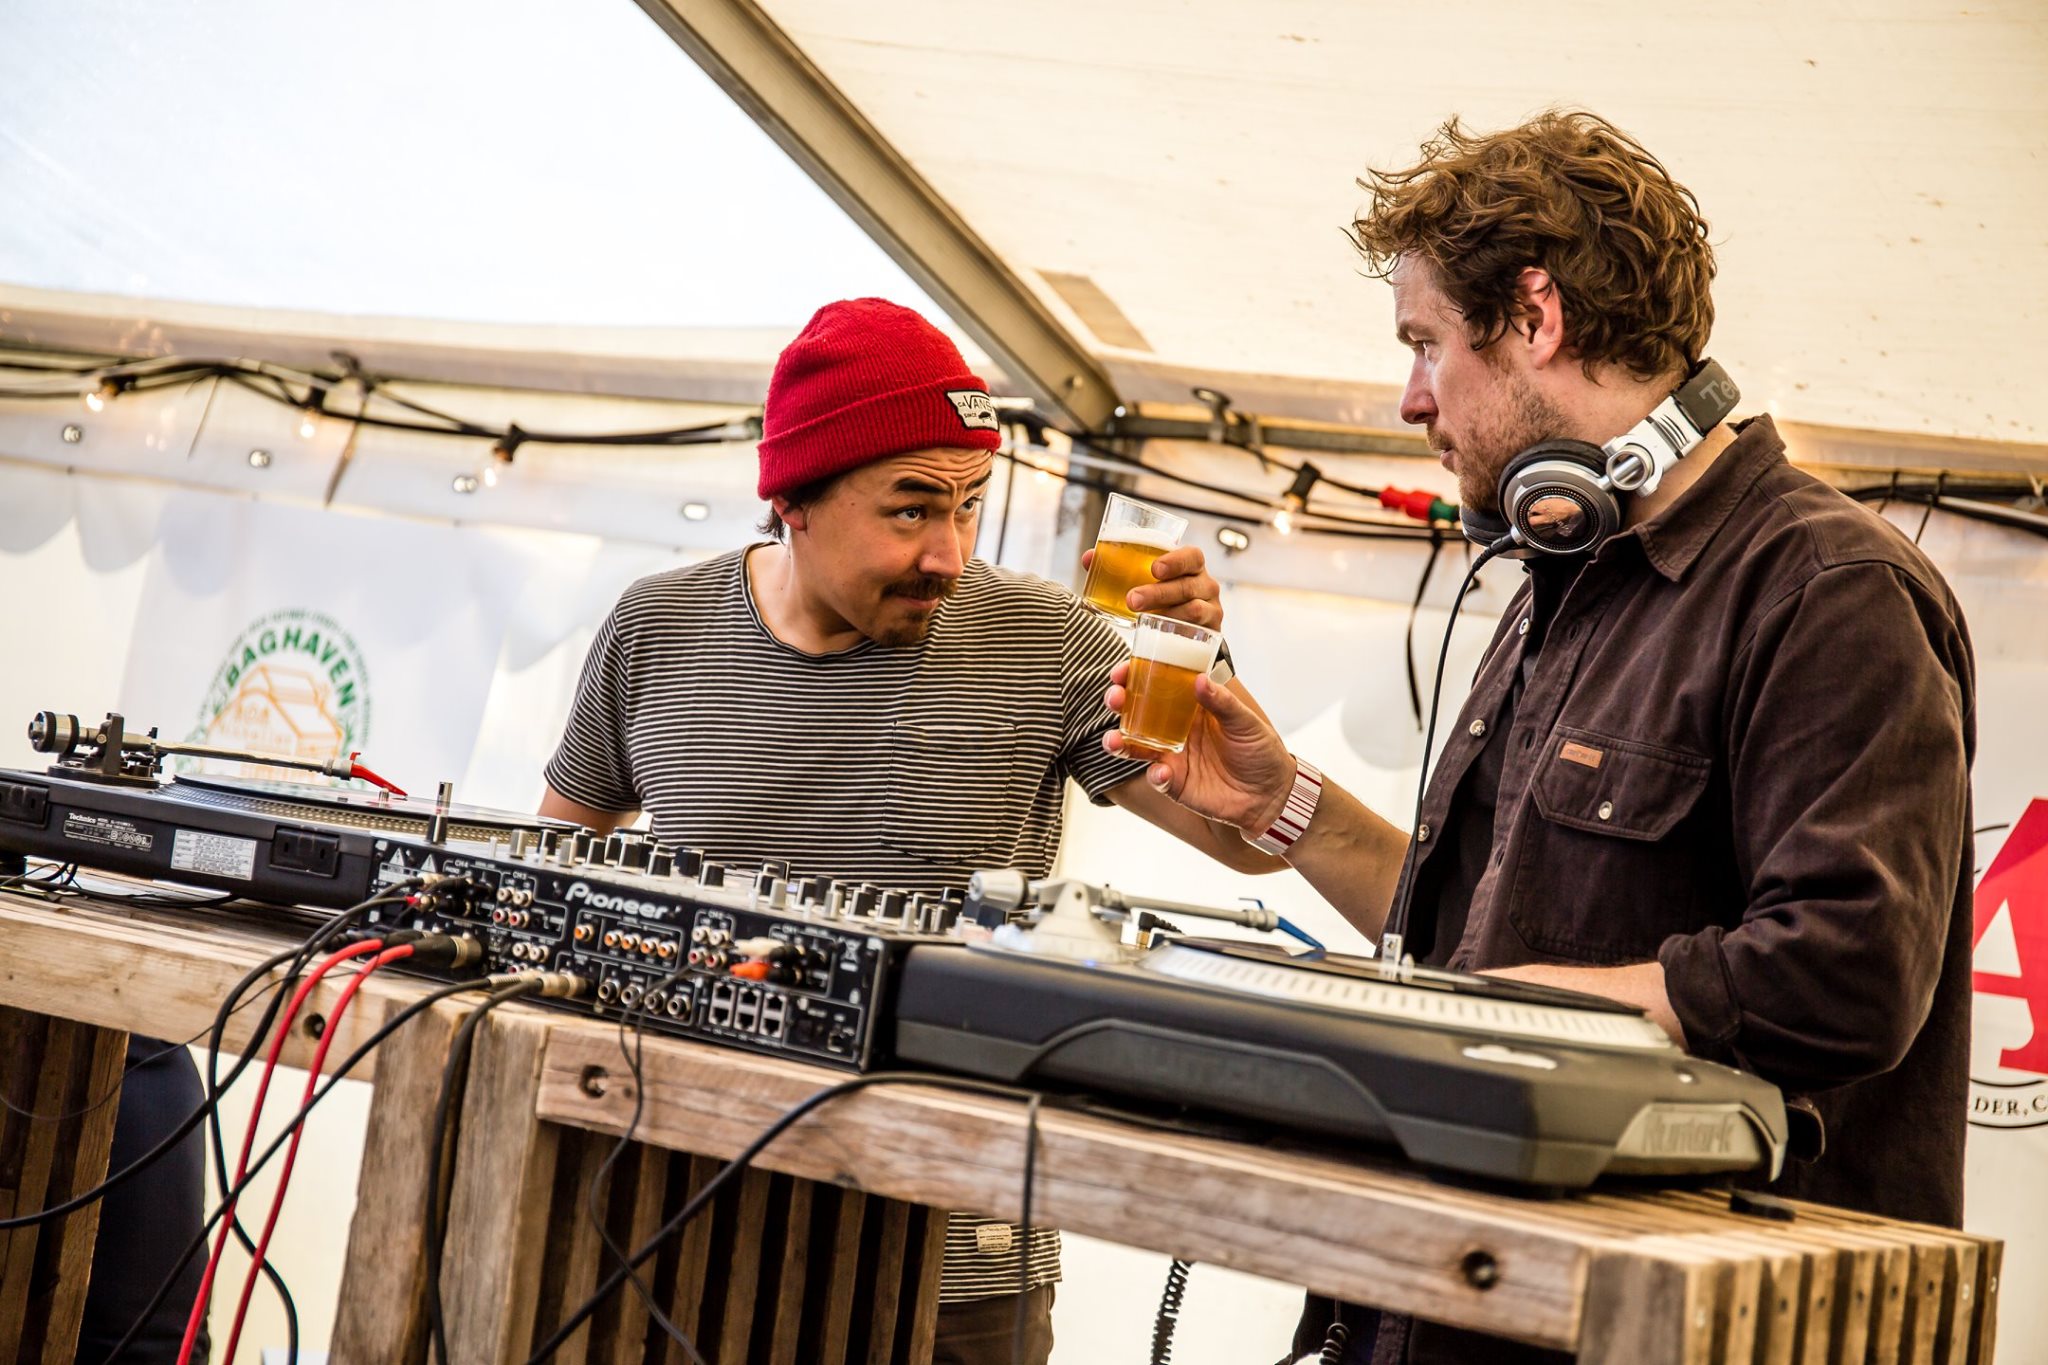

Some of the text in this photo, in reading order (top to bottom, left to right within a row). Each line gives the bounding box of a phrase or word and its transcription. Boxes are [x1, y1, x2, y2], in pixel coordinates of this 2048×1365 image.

[963, 395, 993, 412] VANS
[225, 626, 358, 708] BAGHAVEN
[68, 812, 97, 824] Technics
[564, 881, 669, 920] Pioneer
